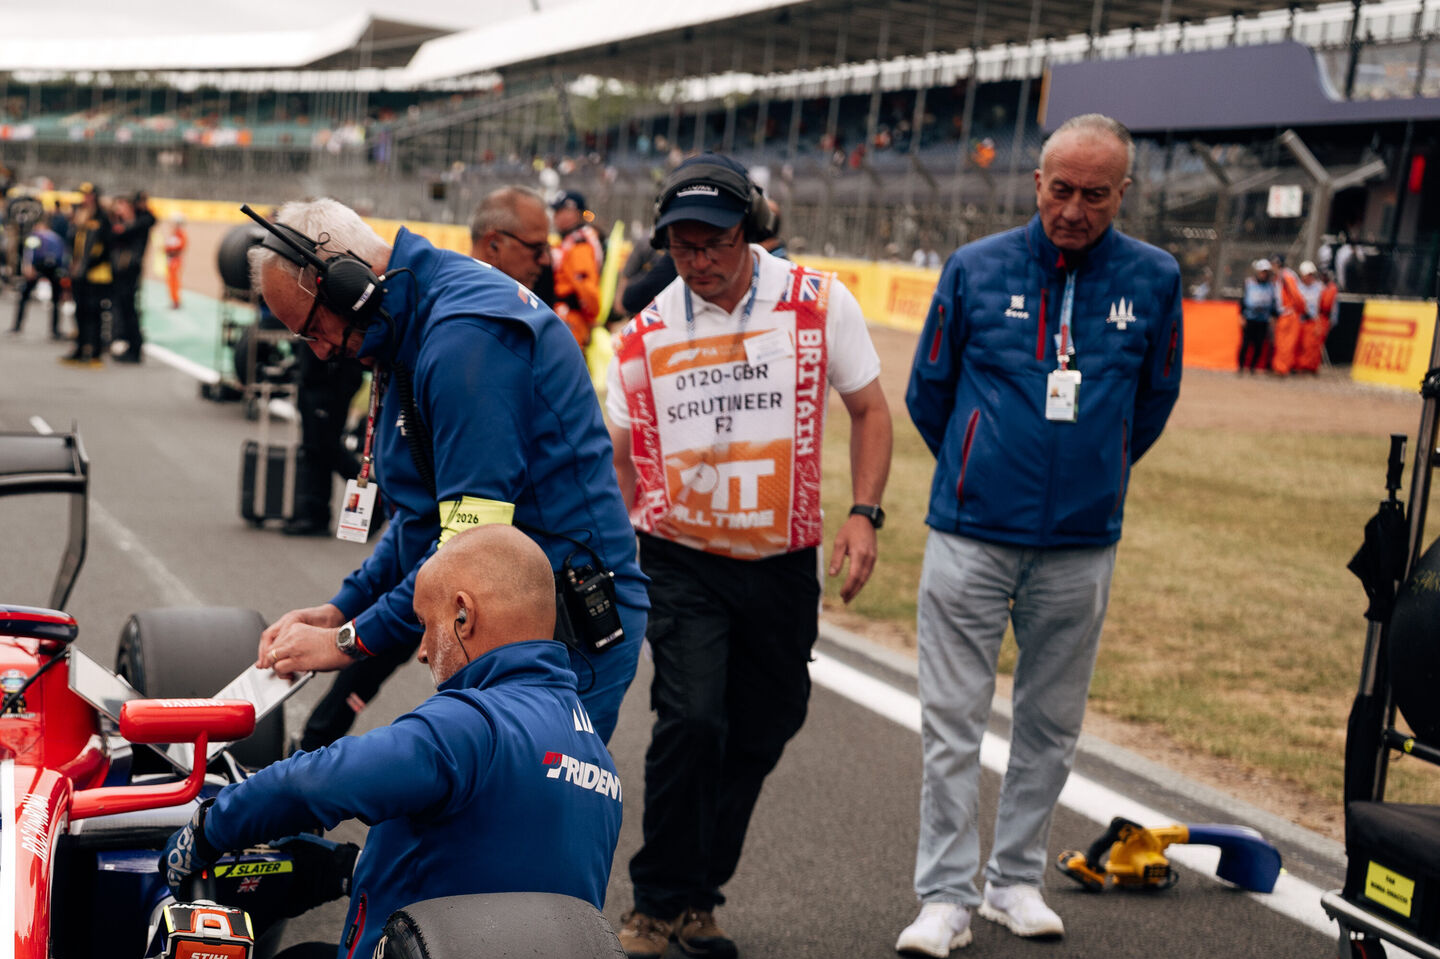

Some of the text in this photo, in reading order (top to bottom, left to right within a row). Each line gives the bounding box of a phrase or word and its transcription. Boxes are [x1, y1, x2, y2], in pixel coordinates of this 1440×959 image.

[676, 363, 769, 391] 0120-GBR
[796, 328, 823, 457] BRITAIN
[667, 391, 783, 424] SCRUTINEER
[715, 416, 734, 434] F2
[456, 513, 479, 524] 2026
[712, 509, 774, 529] TIME
[236, 862, 281, 875] SLATER
